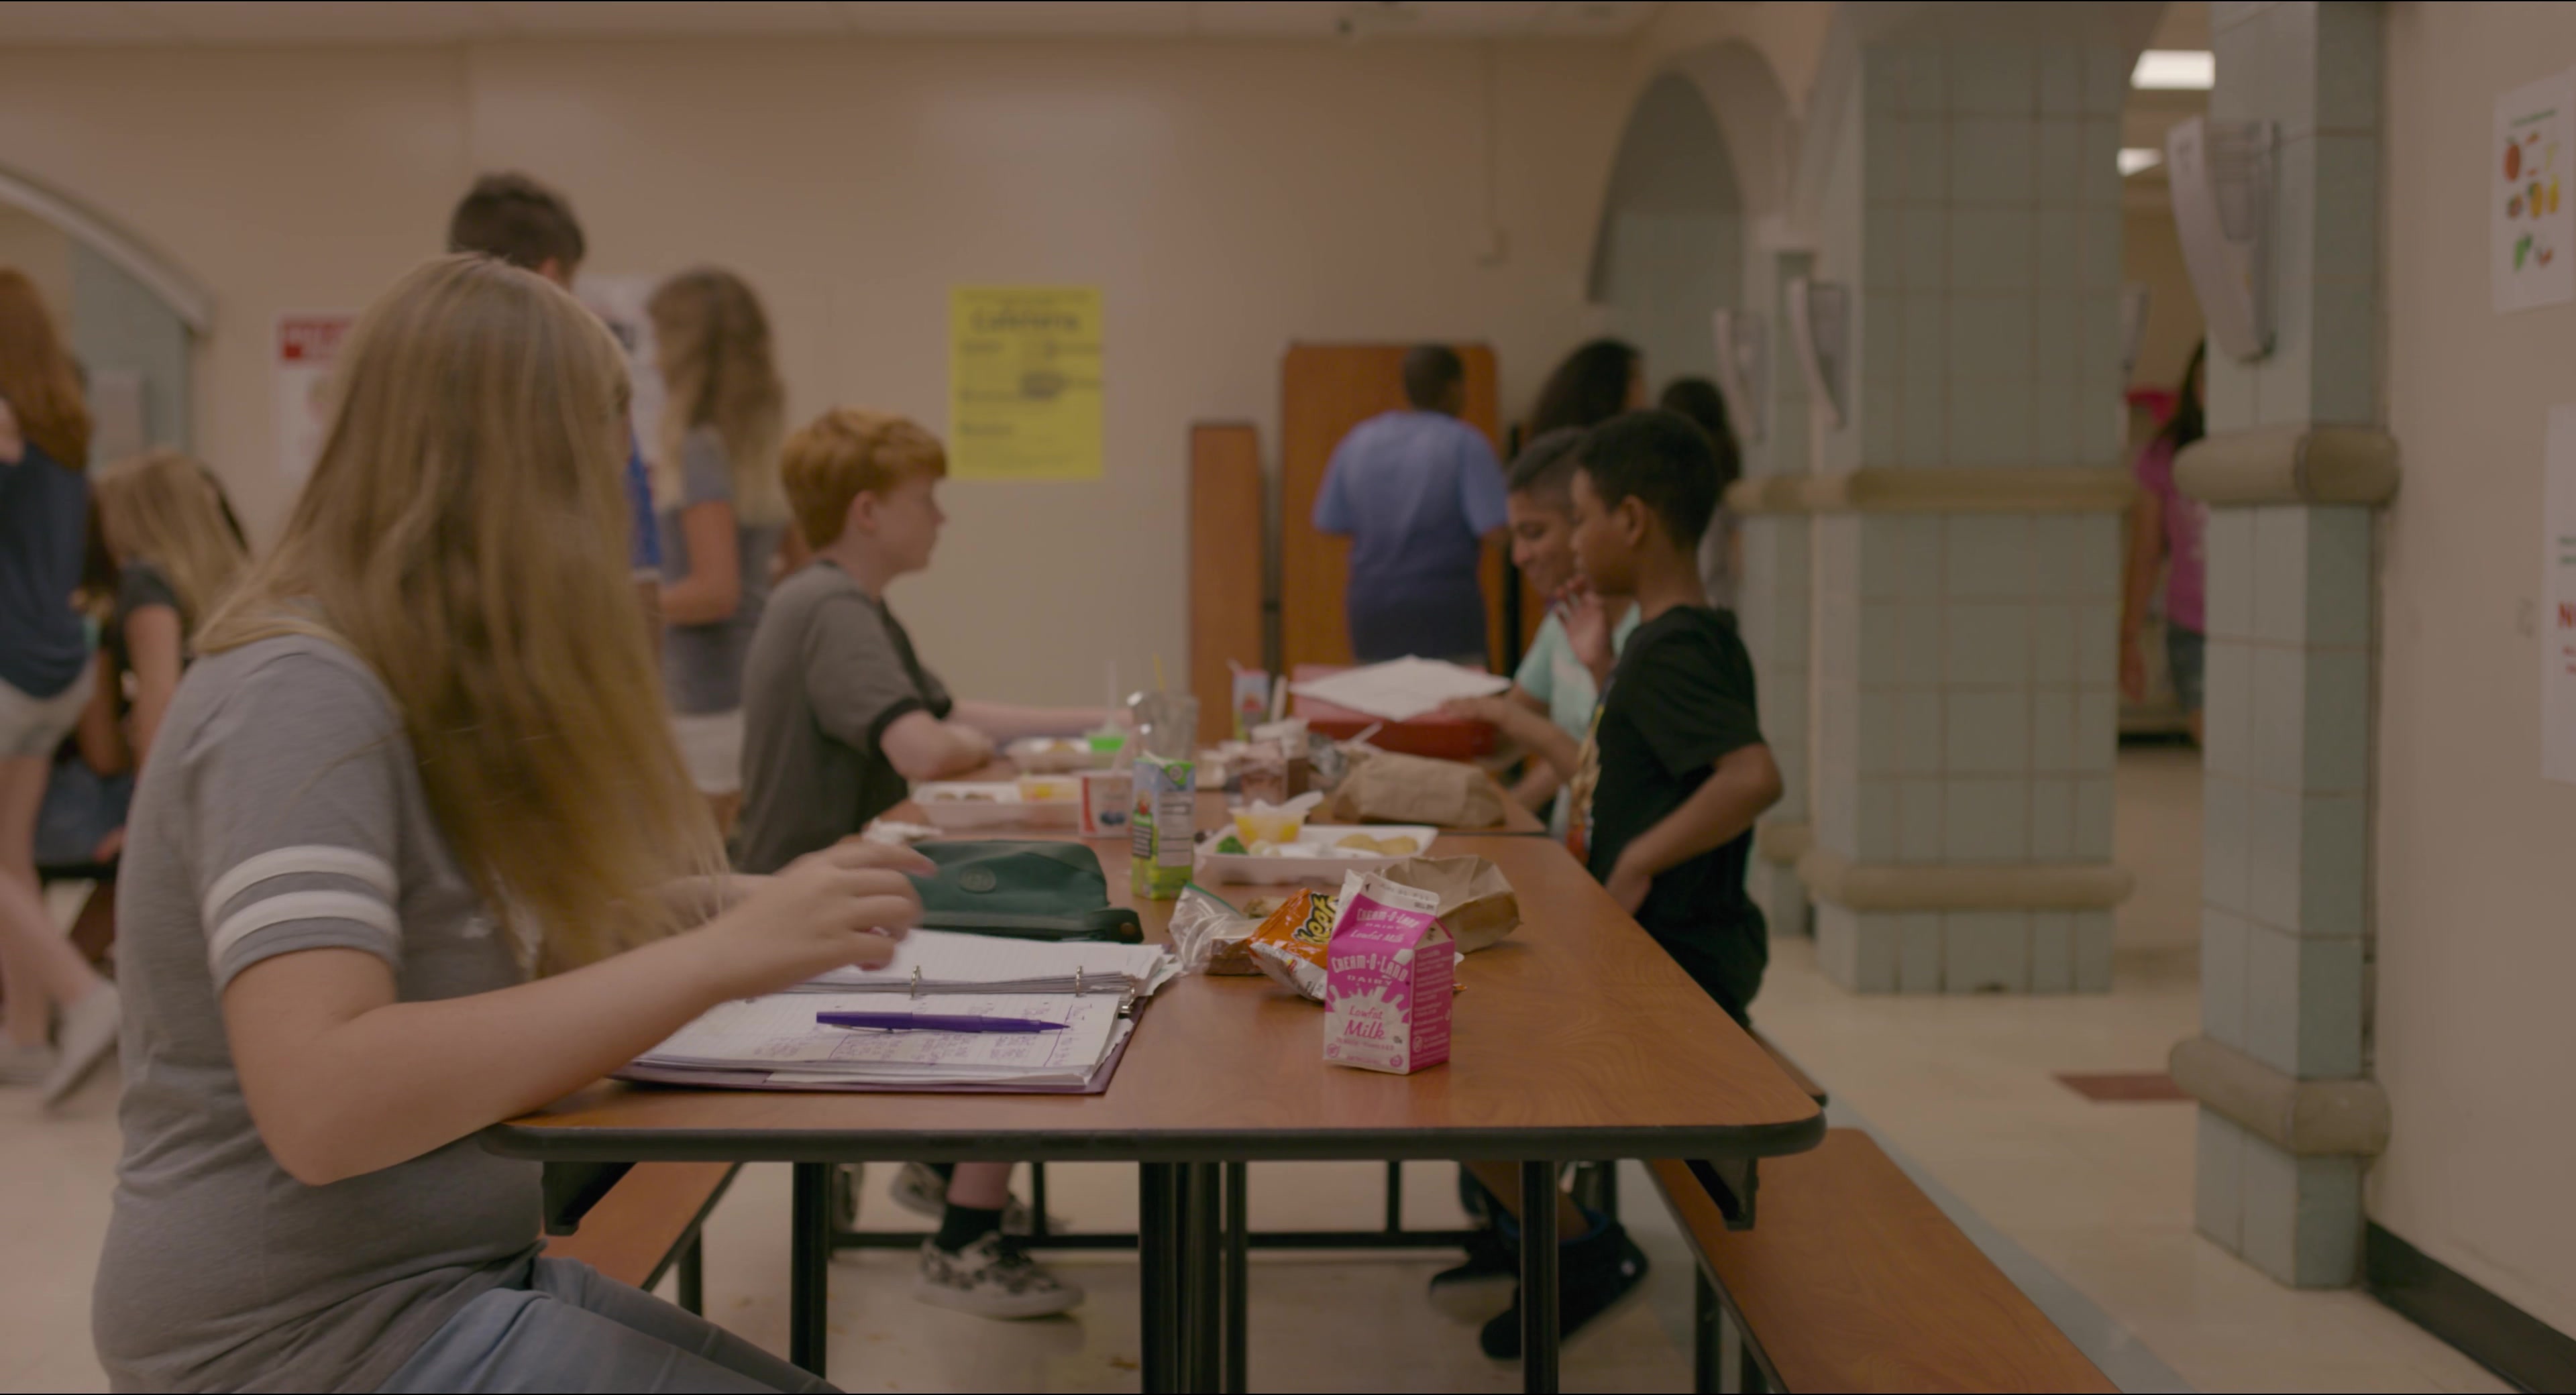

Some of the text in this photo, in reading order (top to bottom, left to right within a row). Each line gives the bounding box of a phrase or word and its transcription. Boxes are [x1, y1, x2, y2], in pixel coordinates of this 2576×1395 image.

[1347, 974, 1393, 986] DAIRY
[1348, 1005, 1383, 1019] Lowfat
[1344, 1019, 1385, 1040] Milk
